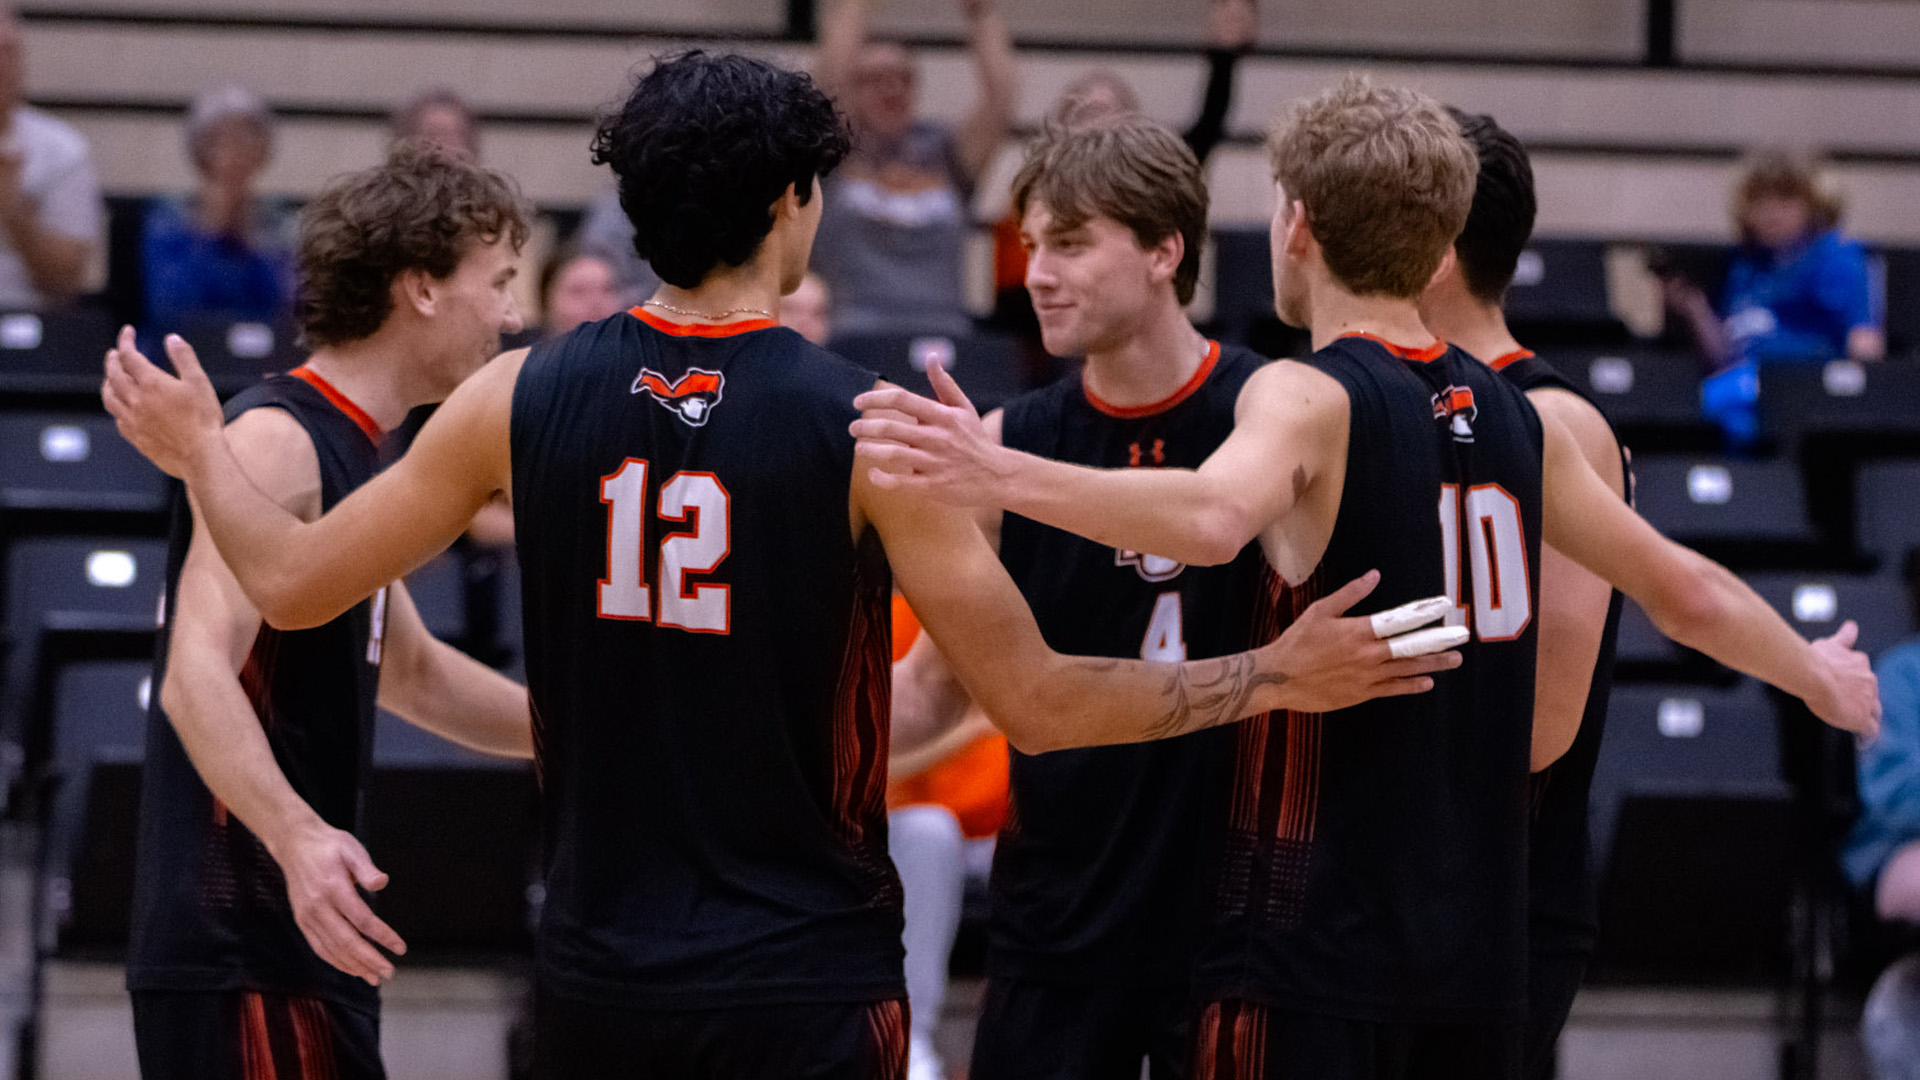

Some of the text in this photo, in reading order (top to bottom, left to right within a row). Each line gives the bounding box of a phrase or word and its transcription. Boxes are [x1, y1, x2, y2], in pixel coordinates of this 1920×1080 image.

[597, 457, 730, 635] 12
[1438, 482, 1532, 642] 10
[1140, 591, 1187, 662] 4
